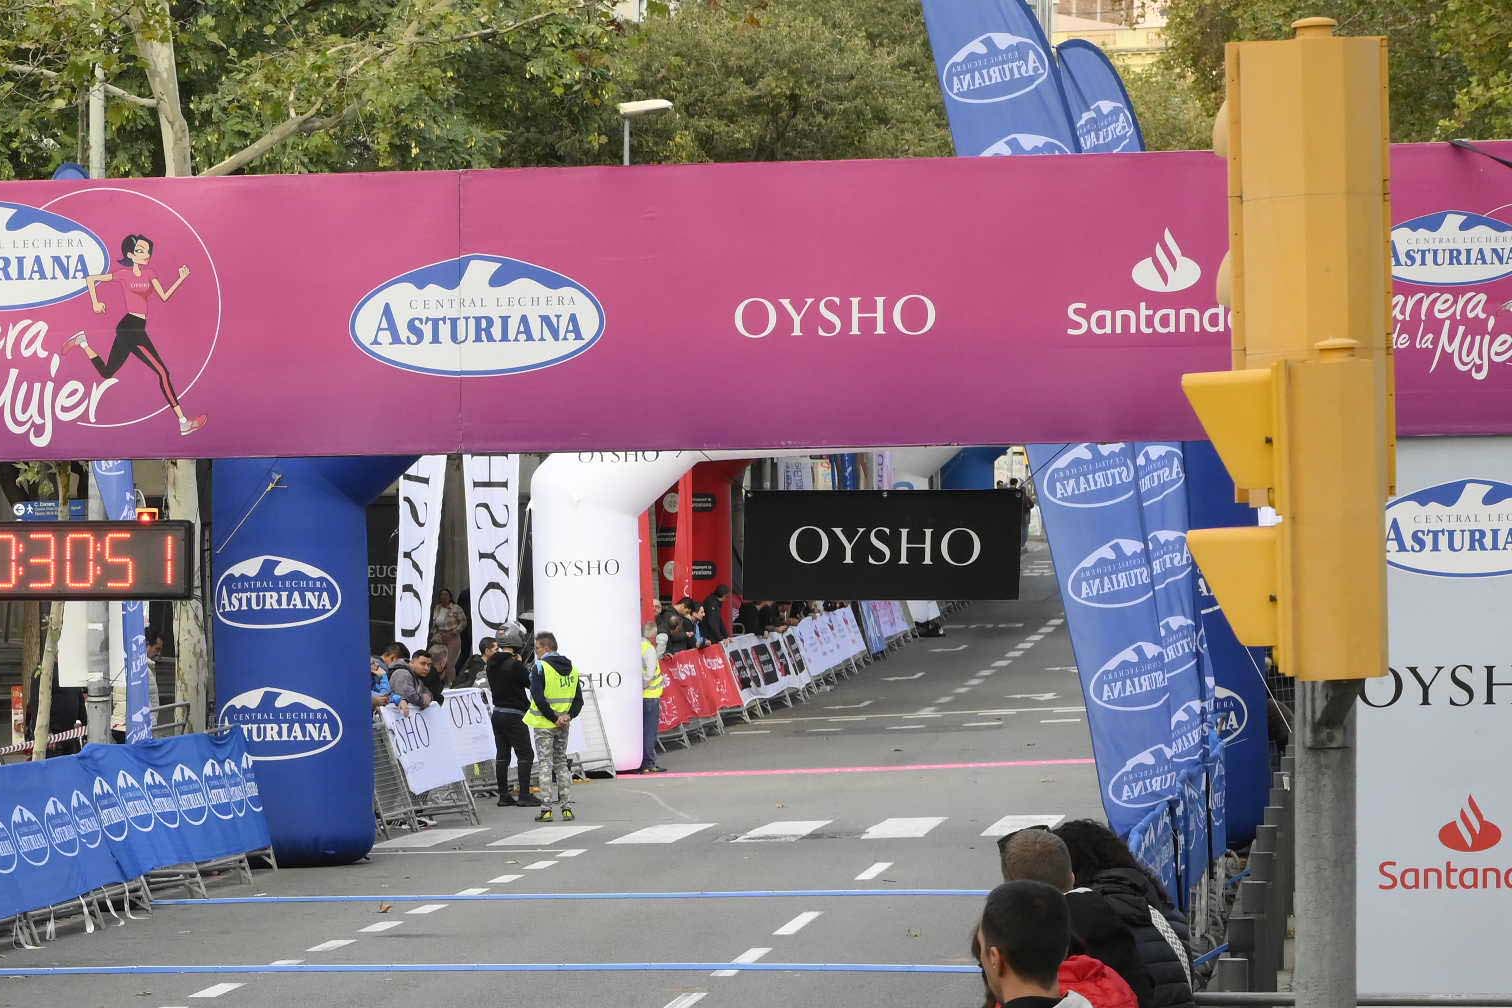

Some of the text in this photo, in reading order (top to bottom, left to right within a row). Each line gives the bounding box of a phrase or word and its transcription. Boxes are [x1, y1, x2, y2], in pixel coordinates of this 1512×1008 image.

[12, 239, 85, 249] LECHERA
[1407, 236, 1458, 245] CENTRAL
[409, 295, 577, 310] CENTRAL LECHERA
[1392, 292, 1487, 321] arrera
[370, 302, 585, 346] ASTURIANA
[734, 294, 937, 339] OYSHO
[1067, 302, 1232, 335] Santand
[1416, 322, 1434, 349] la
[1413, 515, 1481, 523] CENTRAL
[788, 525, 982, 567] OYSHO
[545, 558, 620, 578] OYSHO
[232, 580, 327, 589] CENTRAL LECHERA
[219, 585, 332, 612] ASTURIANA
[233, 712, 328, 721] CENTRAL LECHERA
[237, 721, 333, 742] TURIANA
